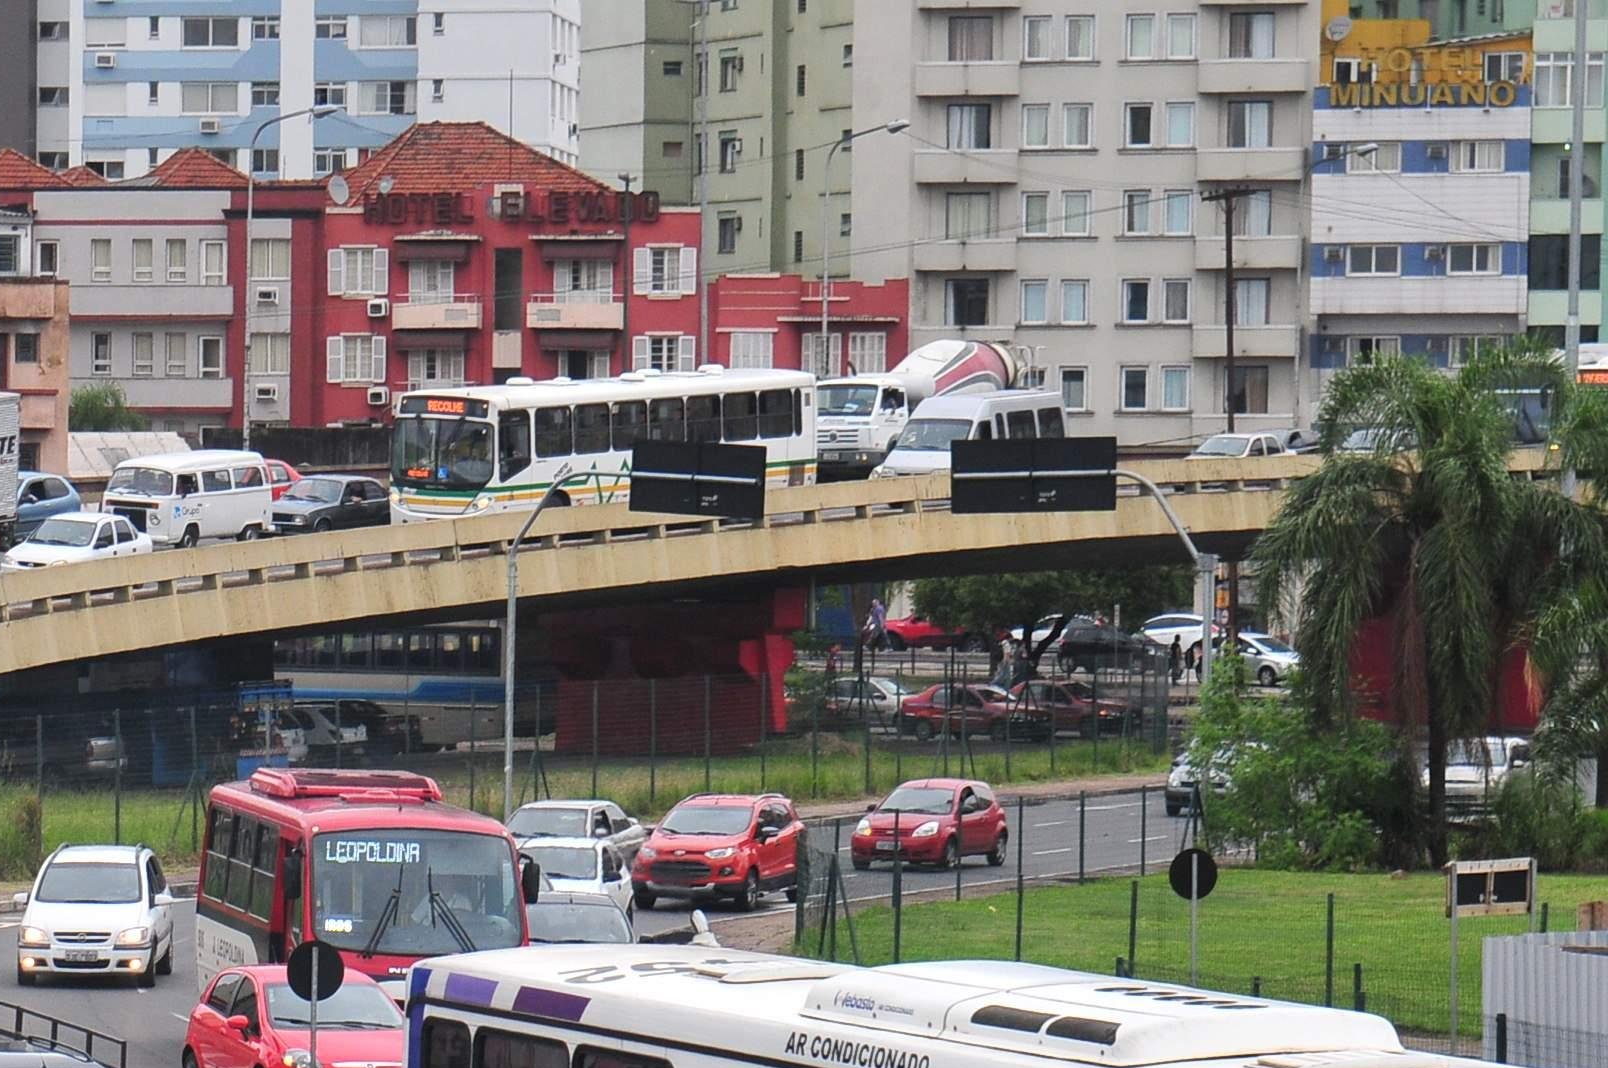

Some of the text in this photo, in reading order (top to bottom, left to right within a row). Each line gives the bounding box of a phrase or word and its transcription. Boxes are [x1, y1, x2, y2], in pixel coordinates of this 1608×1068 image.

[1361, 47, 1483, 72] HOTEL
[1331, 81, 1516, 107] MINUANO
[364, 190, 660, 225] HOTEL ELEVADO
[427, 400, 465, 413] RECOLHE
[325, 840, 421, 864] LEOPOLDINA
[785, 1031, 808, 1057] AR
